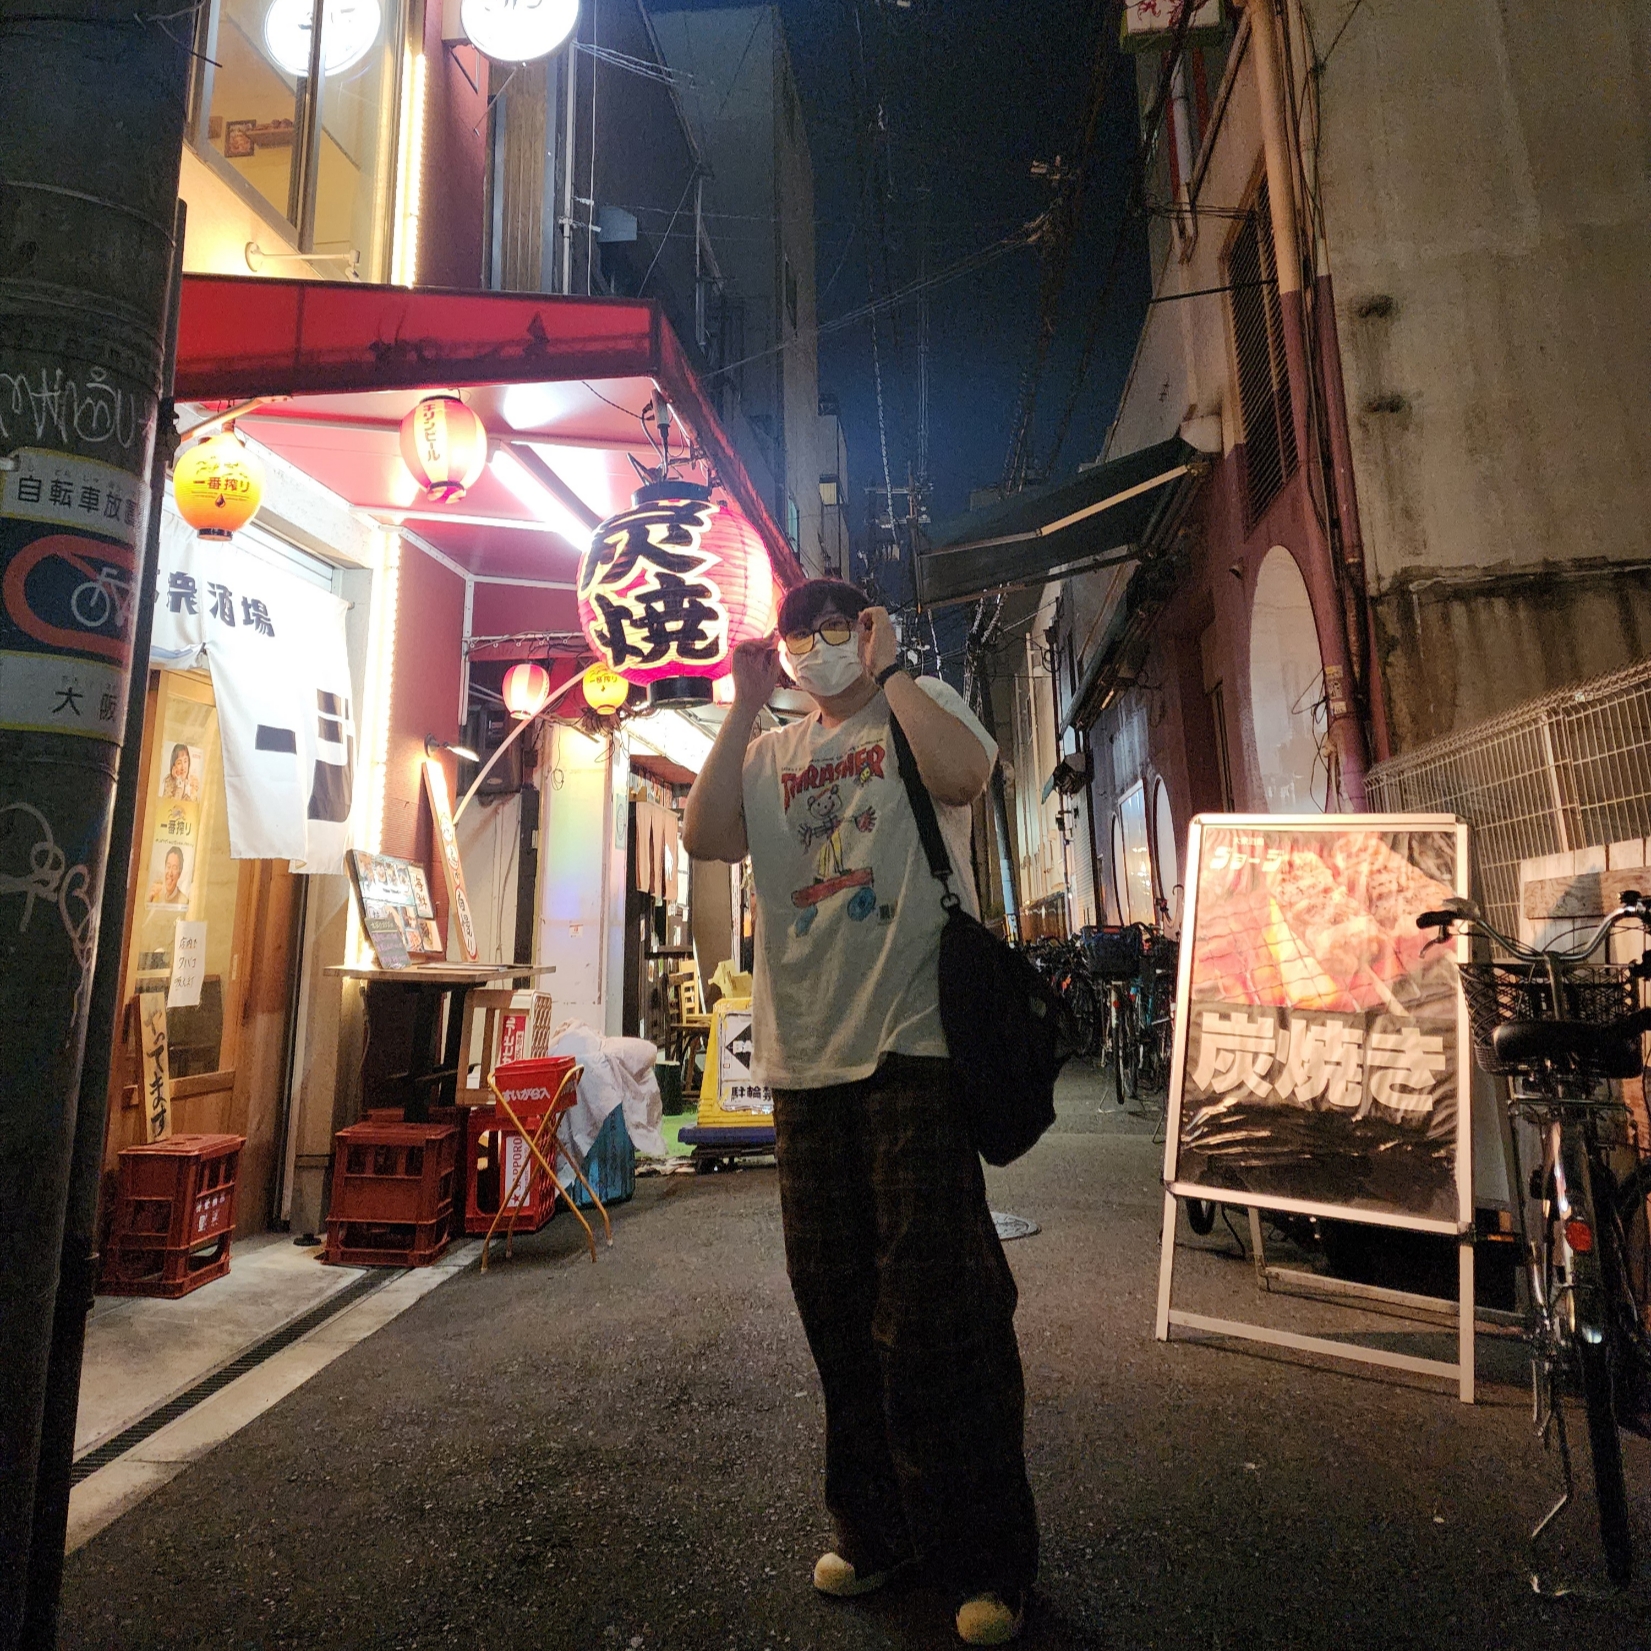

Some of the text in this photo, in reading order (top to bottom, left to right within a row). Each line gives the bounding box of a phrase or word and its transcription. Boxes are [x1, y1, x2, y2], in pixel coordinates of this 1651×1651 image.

[423, 403, 440, 462] キリンビール
[193, 476, 250, 493] 一番搾り
[153, 568, 275, 637] 衆酒場
[782, 744, 886, 815] THRASHER
[160, 820, 192, 836] 一番搾り
[178, 957, 197, 969] タバコ
[144, 1011, 167, 1138] やってます
[1191, 1012, 1446, 1111] 炭焼き
